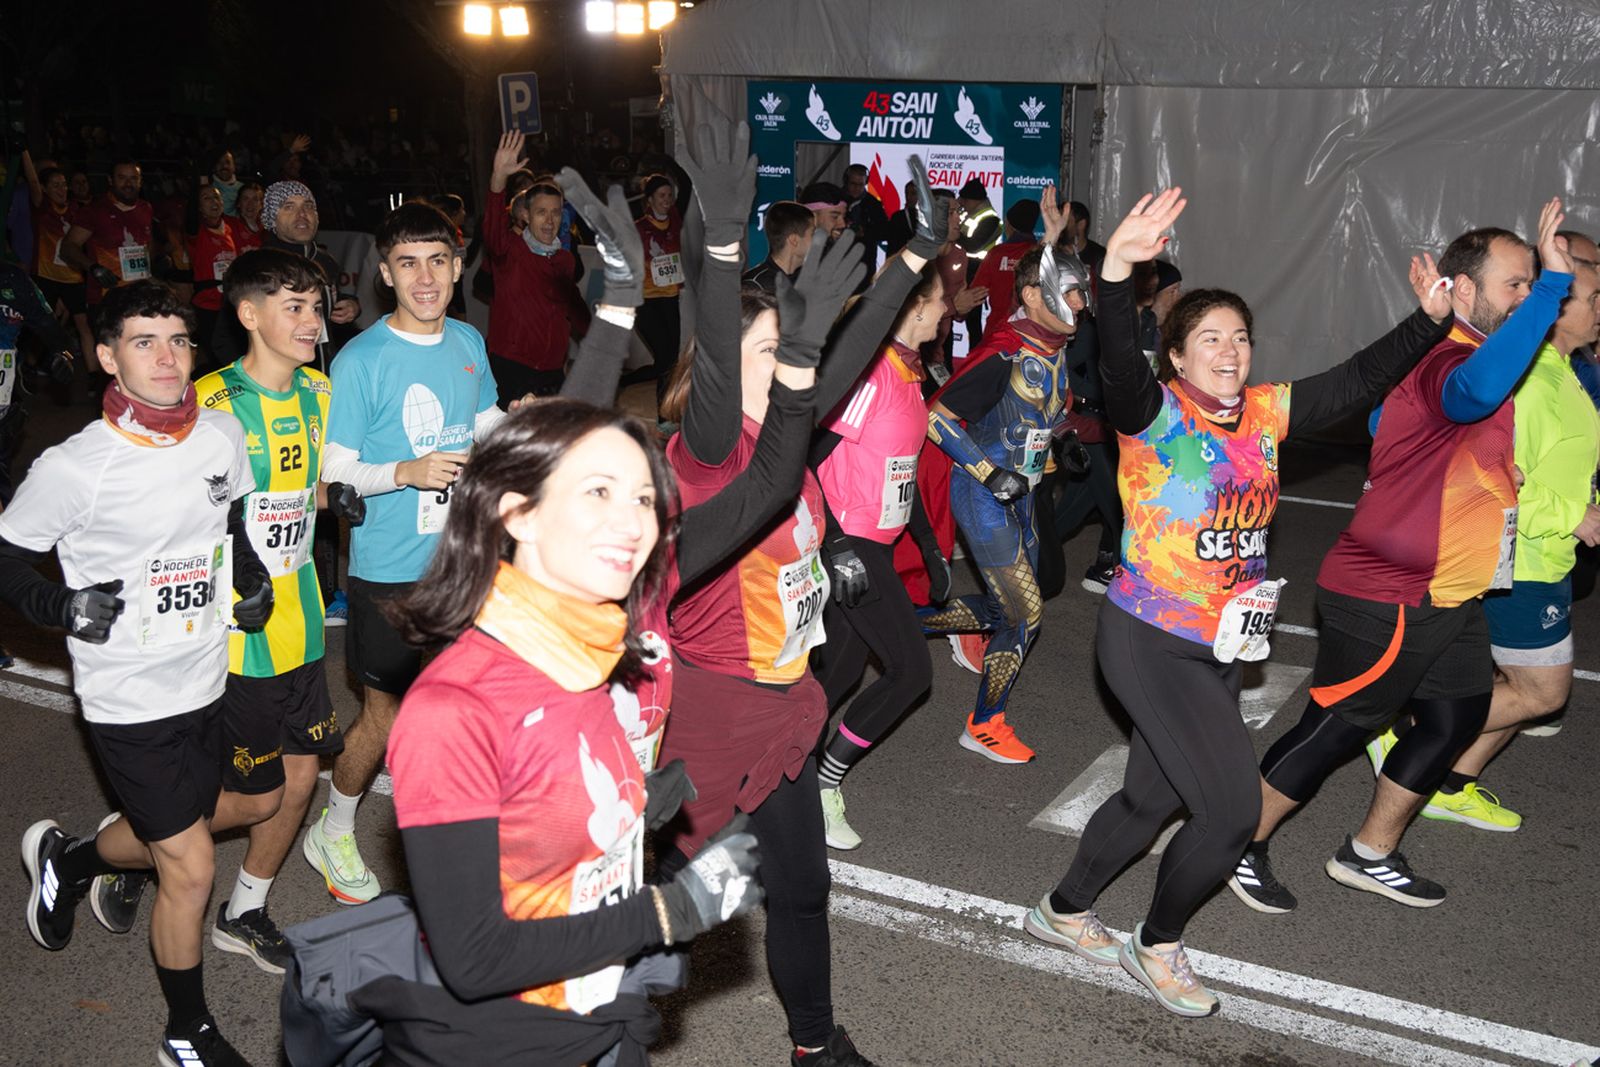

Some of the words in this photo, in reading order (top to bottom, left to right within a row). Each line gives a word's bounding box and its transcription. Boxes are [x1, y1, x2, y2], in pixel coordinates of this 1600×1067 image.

[508, 80, 532, 128] P
[863, 91, 890, 115] 43
[890, 92, 938, 115] SAN
[815, 114, 829, 131] 43
[856, 110, 934, 139] ANTÓN
[965, 119, 980, 135] 43
[1029, 121, 1051, 129] RURAL
[930, 153, 956, 161] CARRERA
[756, 164, 791, 175] alderón
[929, 161, 953, 169] NOCHE
[928, 169, 962, 187] SAN
[1006, 175, 1054, 186] calderón
[205, 384, 245, 408] OEDIM
[415, 435, 435, 448] 40
[279, 444, 302, 473] 22
[270, 501, 297, 511] NOCHE
[1212, 477, 1278, 531] HOY
[257, 512, 278, 523] SAN
[1200, 530, 1233, 560] SE
[163, 560, 196, 572] NOCHE
[196, 557, 208, 567] DE
[150, 574, 171, 587] SAN
[1236, 597, 1257, 608] SAN
